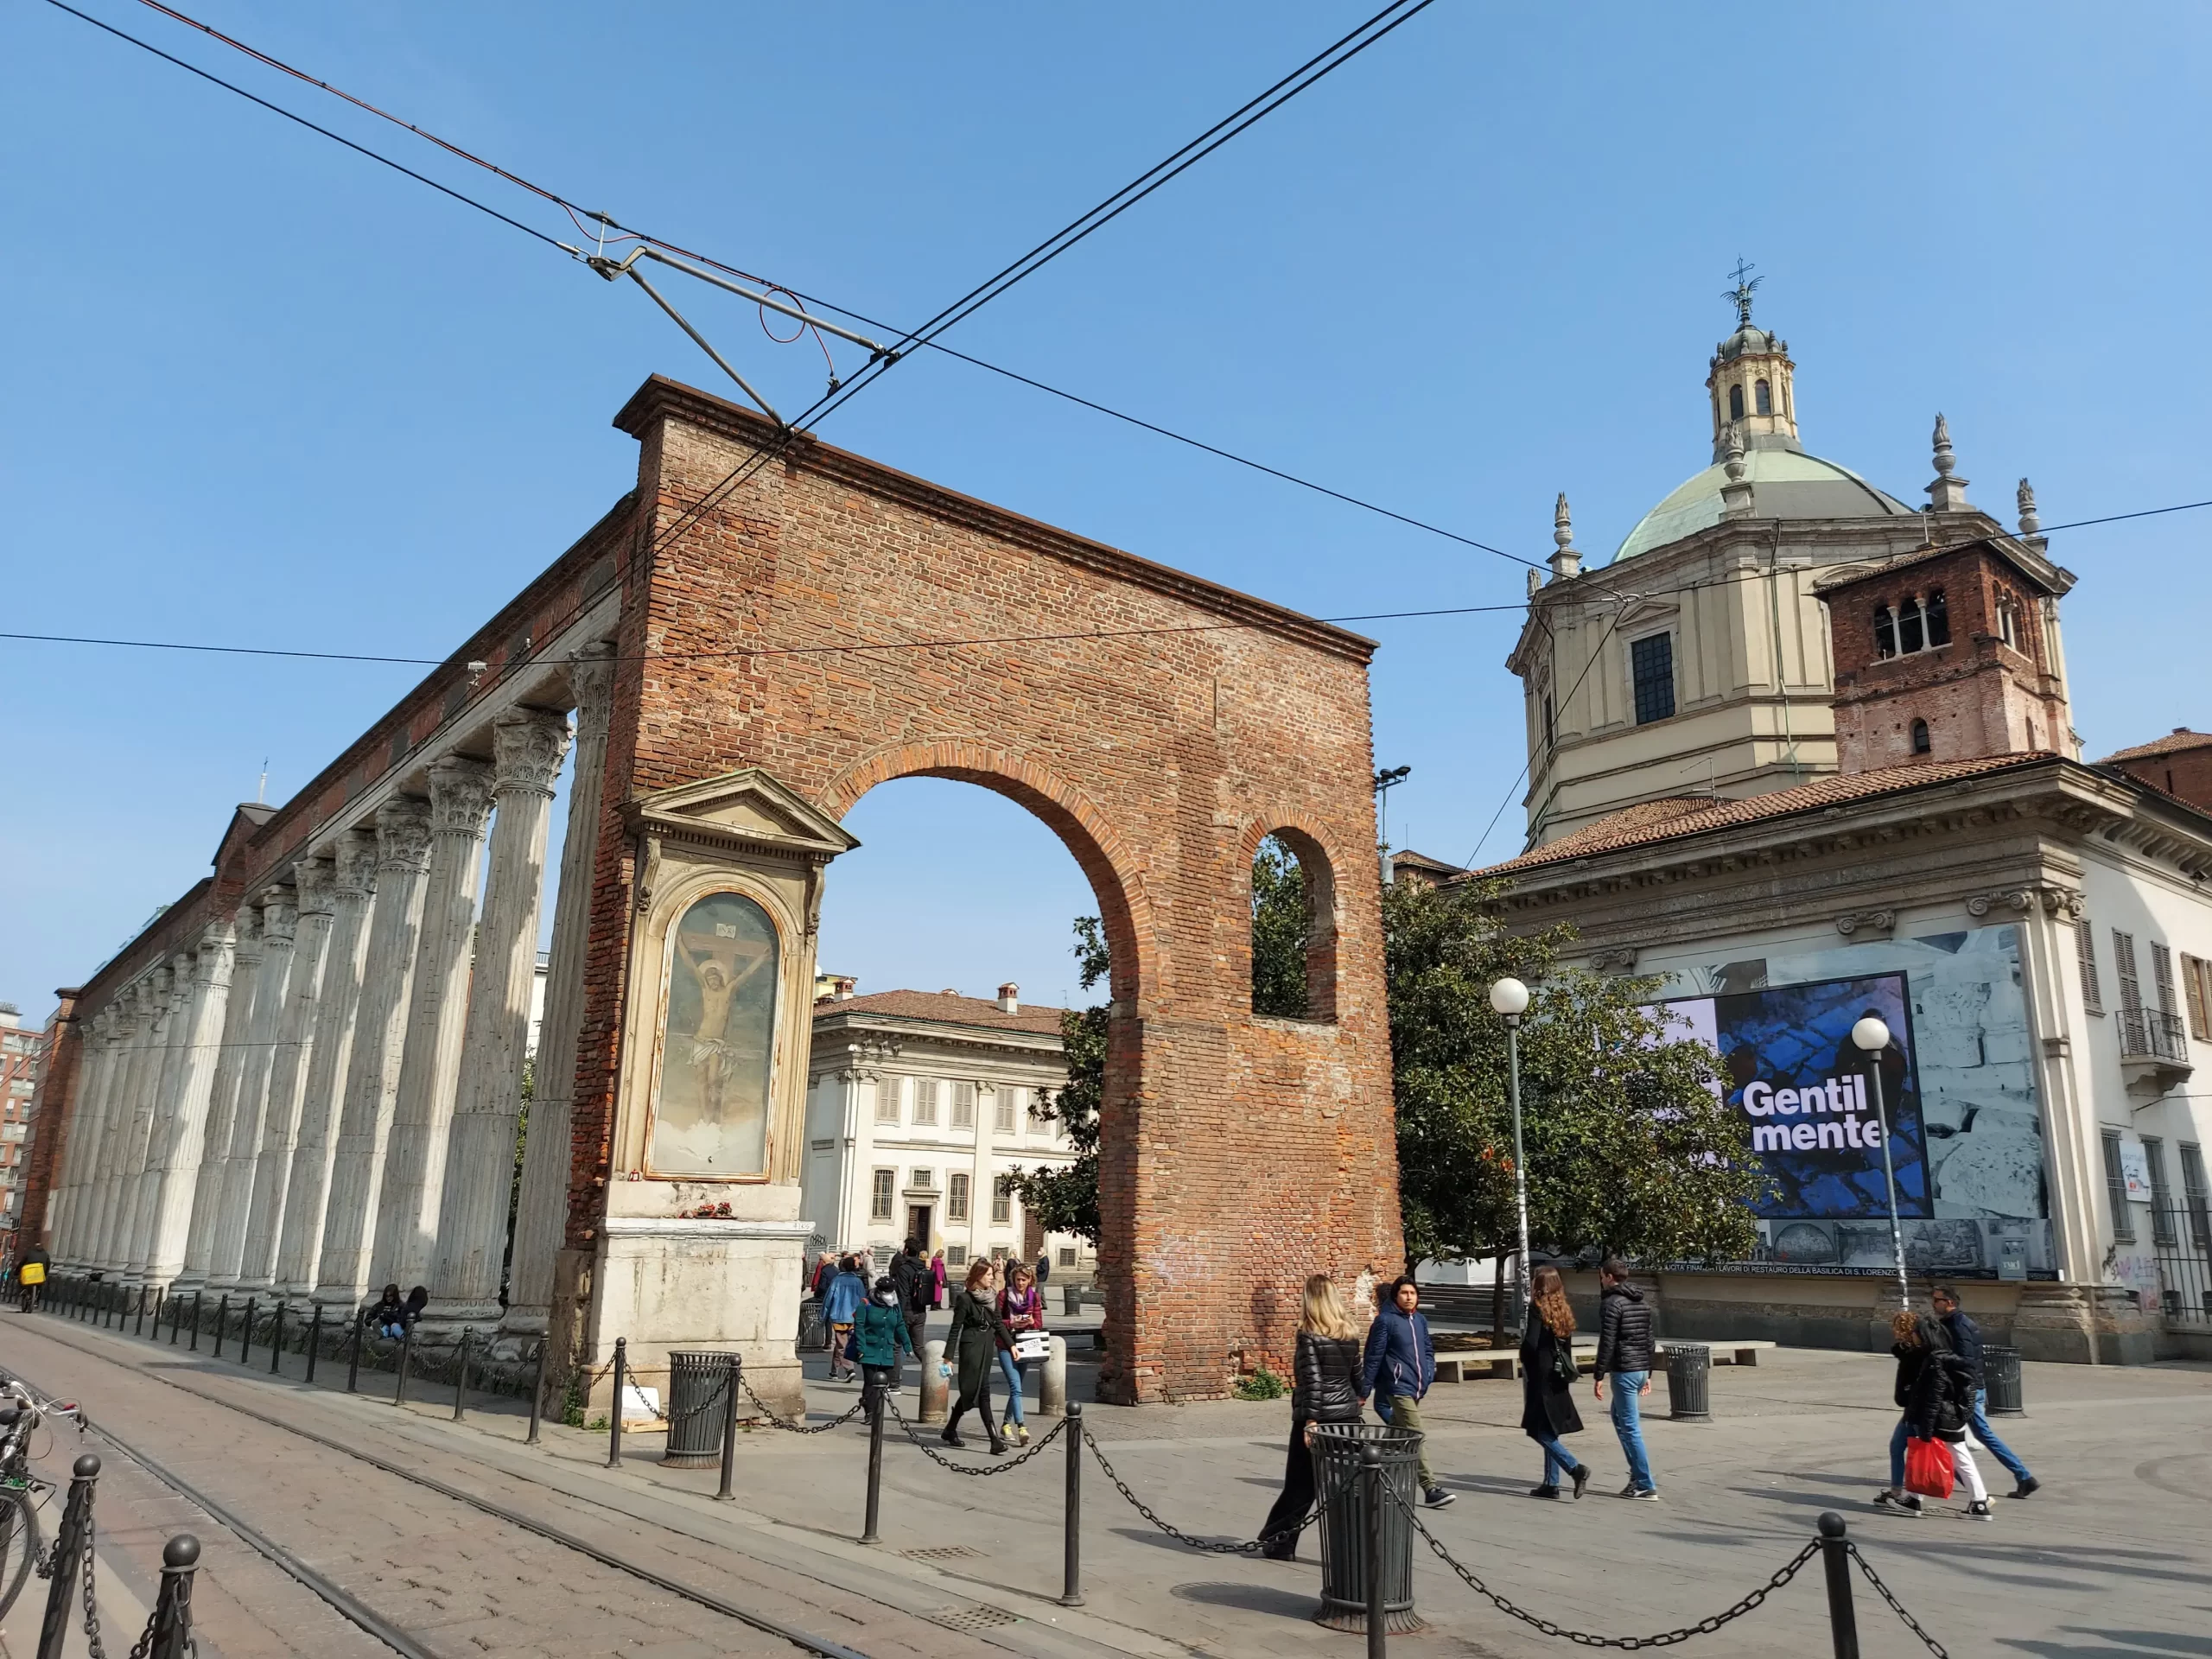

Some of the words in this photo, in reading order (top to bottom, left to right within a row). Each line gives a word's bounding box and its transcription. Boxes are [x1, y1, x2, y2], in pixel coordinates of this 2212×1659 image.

[1743, 1074, 1867, 1116] Gentil
[1752, 1114, 1882, 1152] mente
[1812, 1267, 1844, 1275] BASILICA
